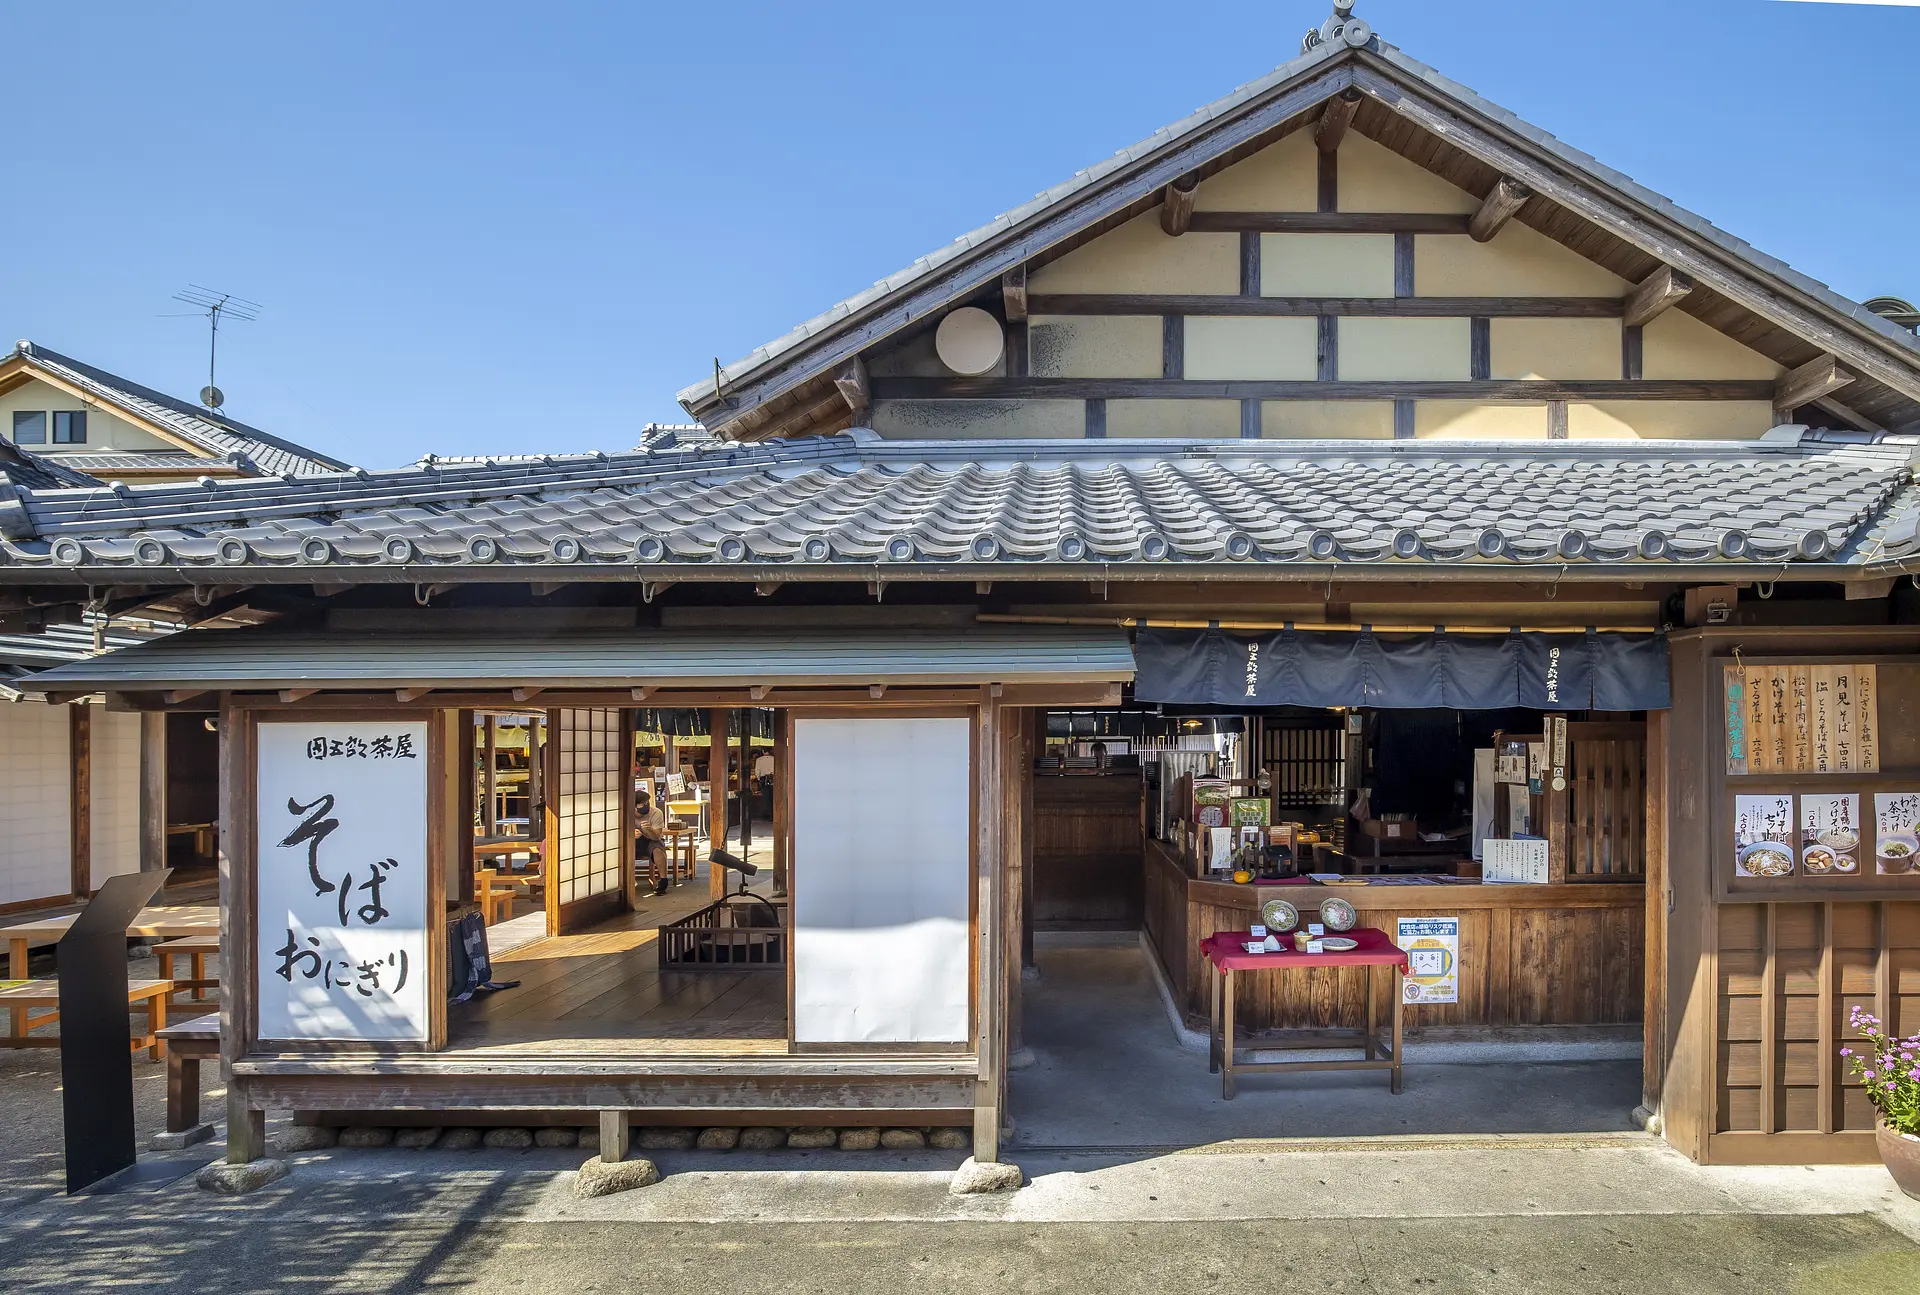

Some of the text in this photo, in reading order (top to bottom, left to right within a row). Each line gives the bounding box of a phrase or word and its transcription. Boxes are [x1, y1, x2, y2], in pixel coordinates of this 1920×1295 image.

[1830, 800, 1840, 836] つけそば
[1888, 801, 1900, 833] 茶づけ
[1900, 797, 1912, 828] わさび
[1910, 794, 1919, 818] 冷やし
[1764, 814, 1776, 840] セット
[277, 793, 398, 926] そば
[276, 928, 408, 997] おにぎり
